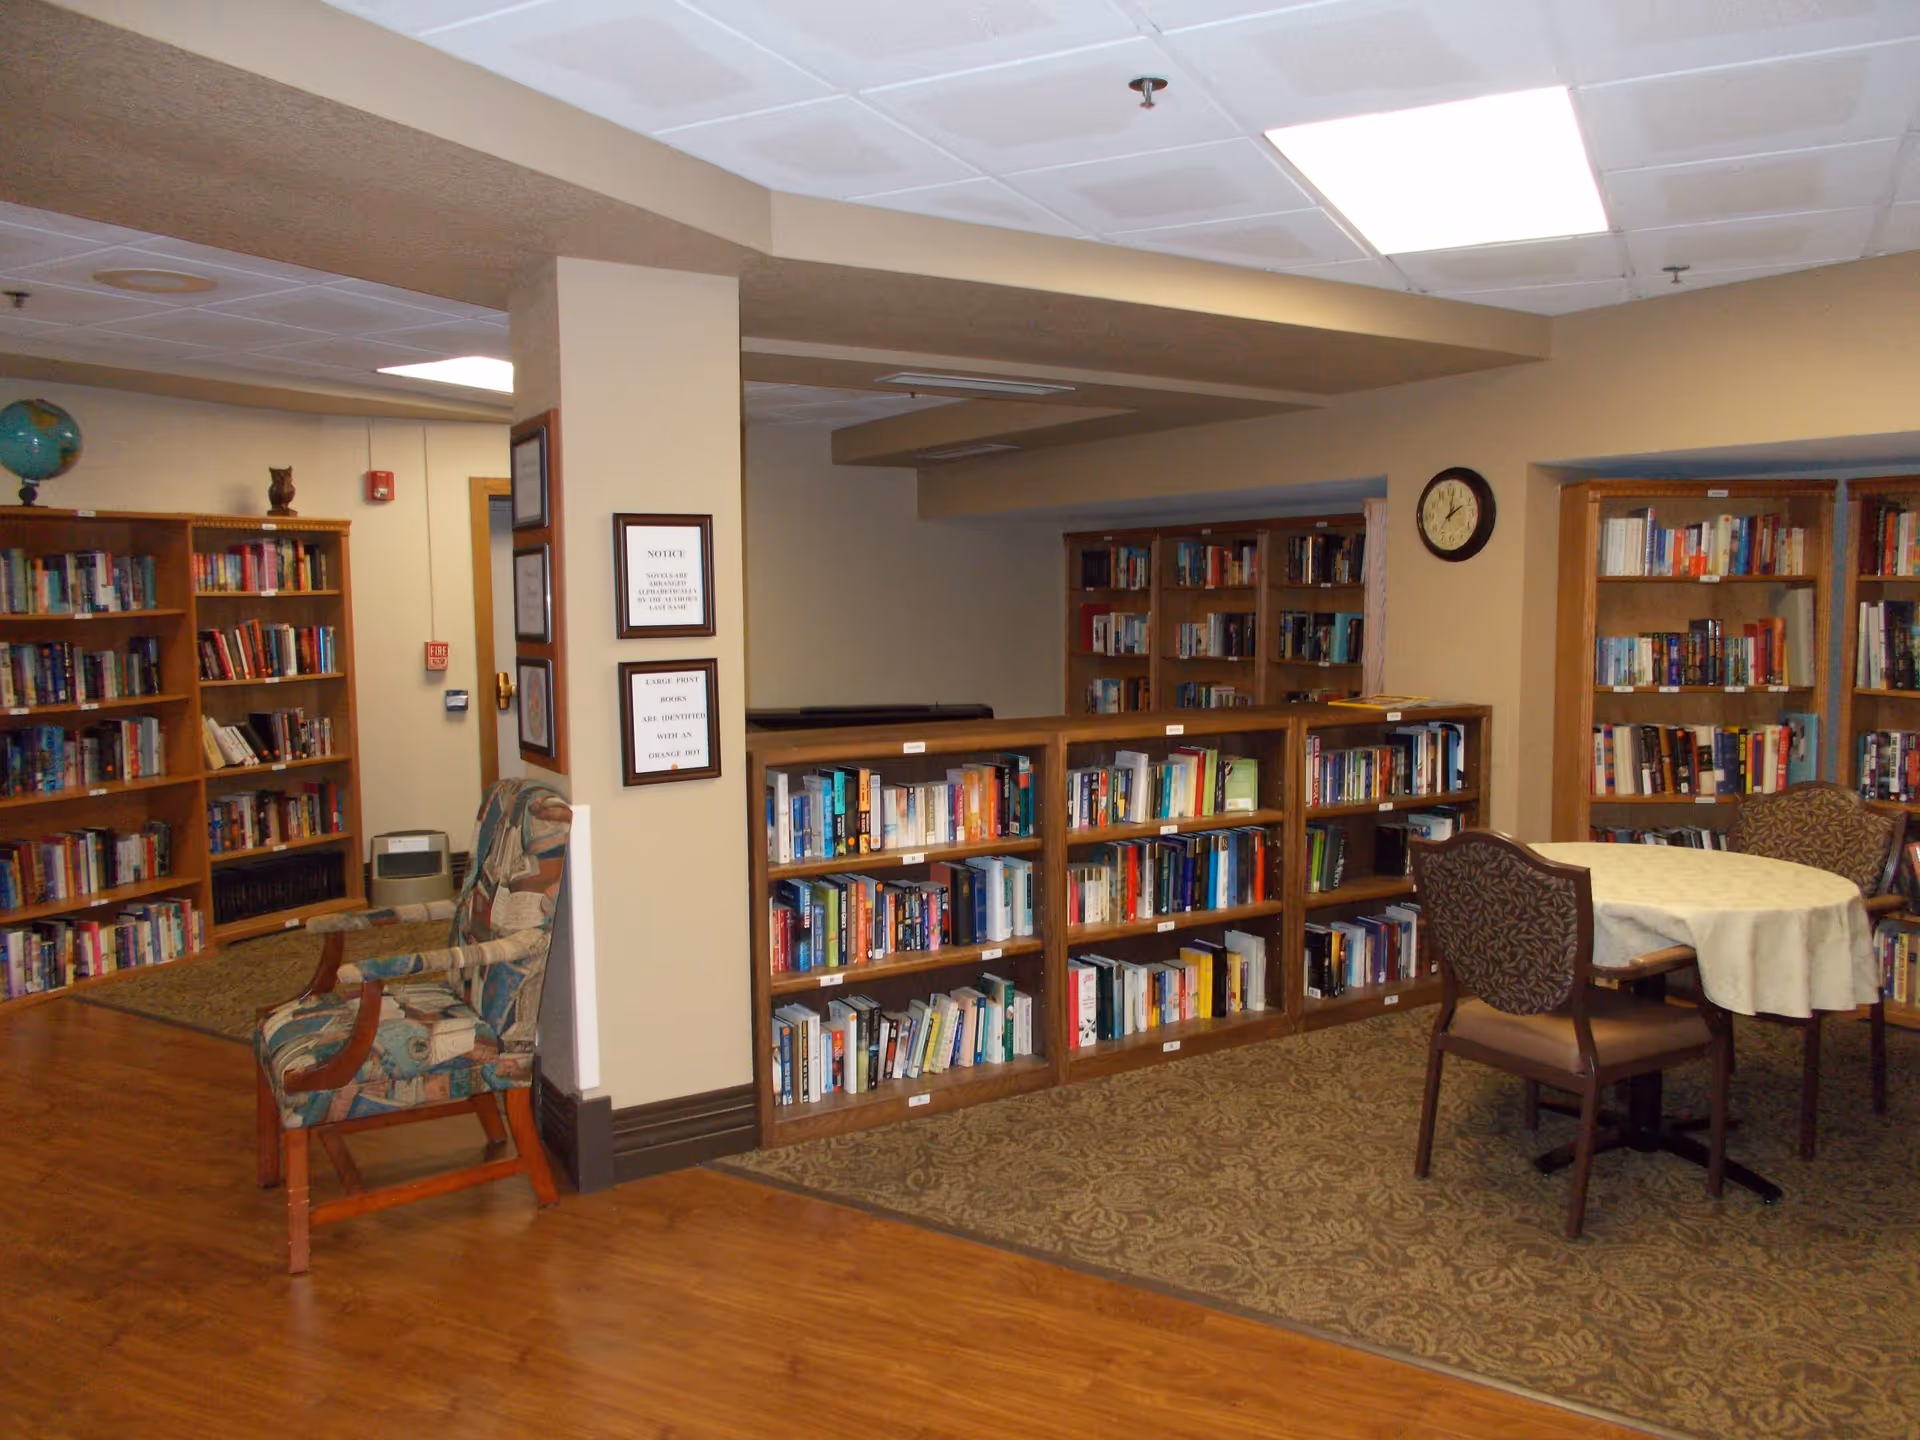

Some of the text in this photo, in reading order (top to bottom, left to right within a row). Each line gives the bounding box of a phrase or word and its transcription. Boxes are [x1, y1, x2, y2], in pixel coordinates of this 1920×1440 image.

[647, 550, 684, 558] NOTICE
[430, 645, 447, 657] FIRE
[676, 676, 699, 684] PRINT
[661, 712, 706, 721] IDENTIFIED
[657, 732, 678, 740] WITH
[648, 750, 680, 759] ORANGE
